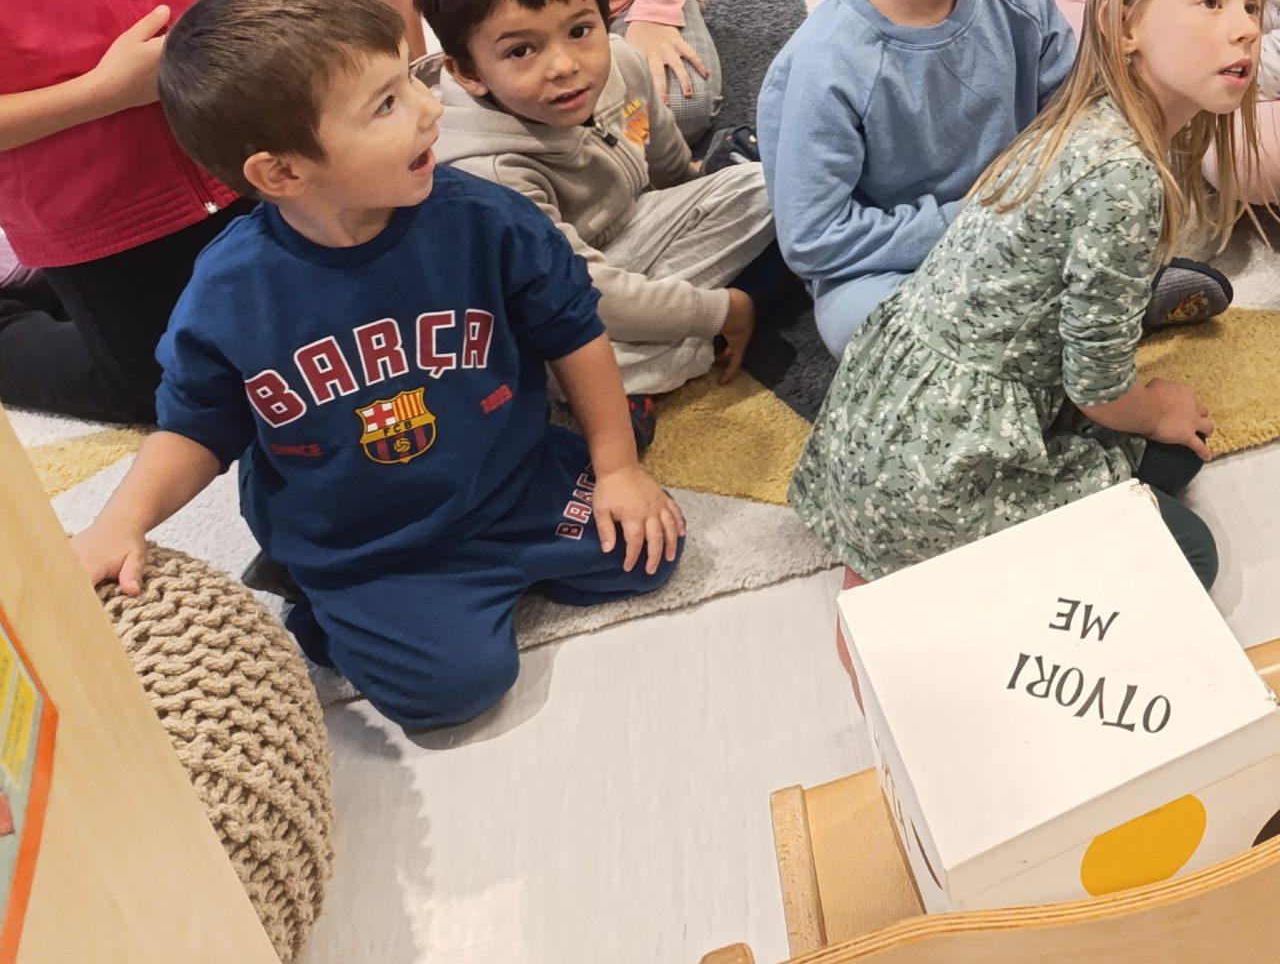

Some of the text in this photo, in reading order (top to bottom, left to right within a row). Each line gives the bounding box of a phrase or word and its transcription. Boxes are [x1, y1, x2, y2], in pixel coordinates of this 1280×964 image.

[245, 308, 494, 429] BARÇA
[1048, 597, 1121, 642] ME
[1006, 652, 1172, 734] OTVORI
